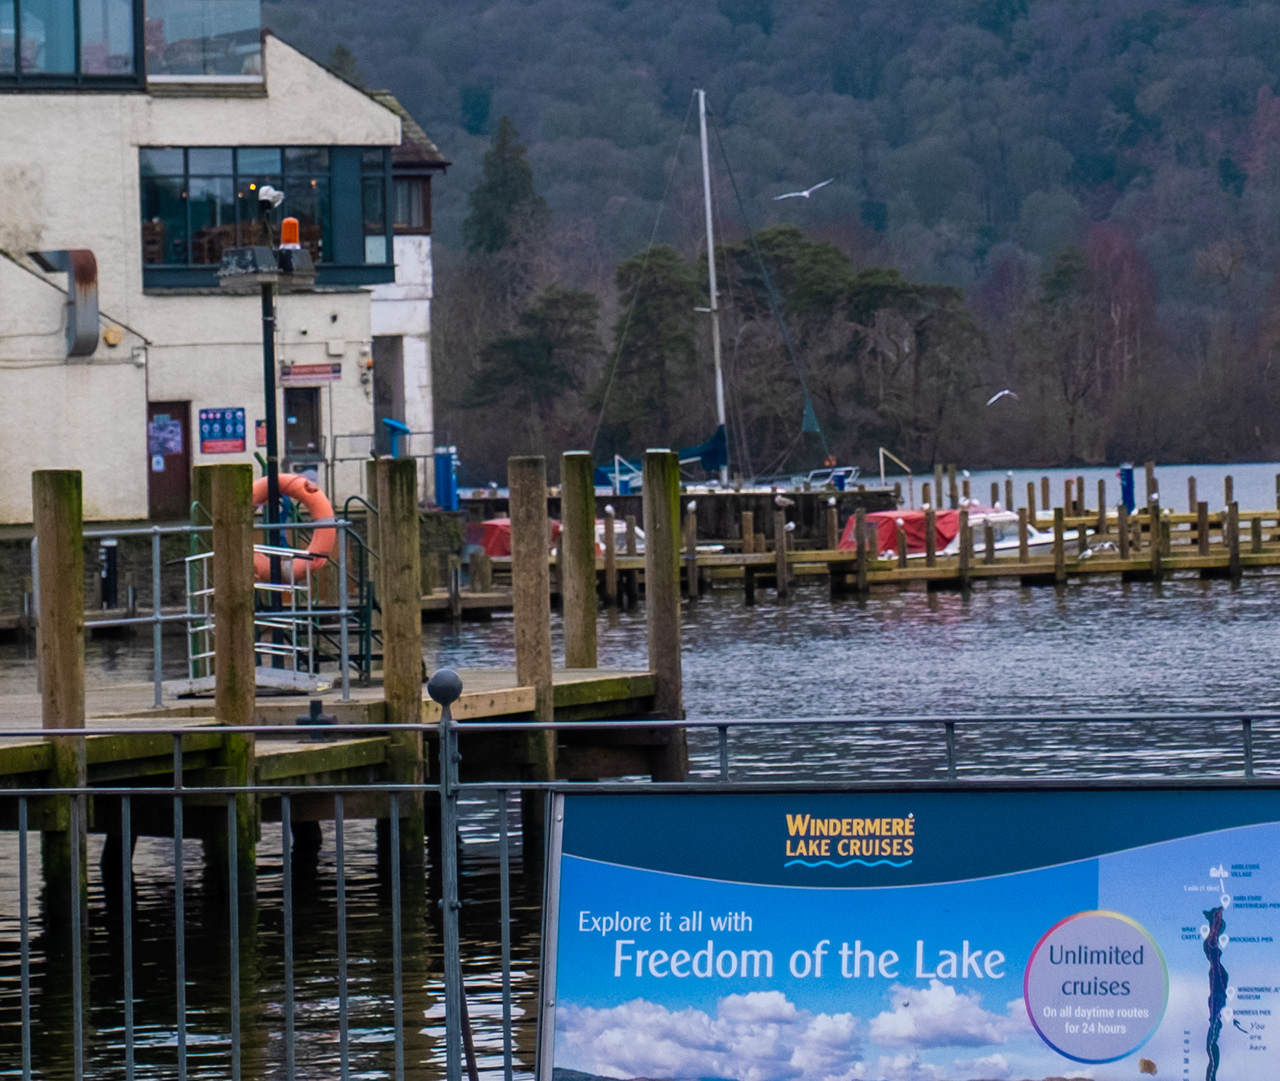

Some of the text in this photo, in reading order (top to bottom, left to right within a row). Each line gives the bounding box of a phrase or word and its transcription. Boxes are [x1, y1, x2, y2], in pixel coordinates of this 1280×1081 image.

[786, 814, 915, 836] WINDERMERE
[786, 839, 914, 856] LAKE CRUISES
[578, 911, 753, 936] Explore it all with
[613, 939, 1006, 978] Freedom of the Lake
[1049, 945, 1144, 965] Unlimited
[1061, 976, 1131, 996] cruises
[1043, 1006, 1149, 1020] On all daytime routes
[1065, 1022, 1126, 1034] for 24 hours
[1250, 1022, 1265, 1030] You
